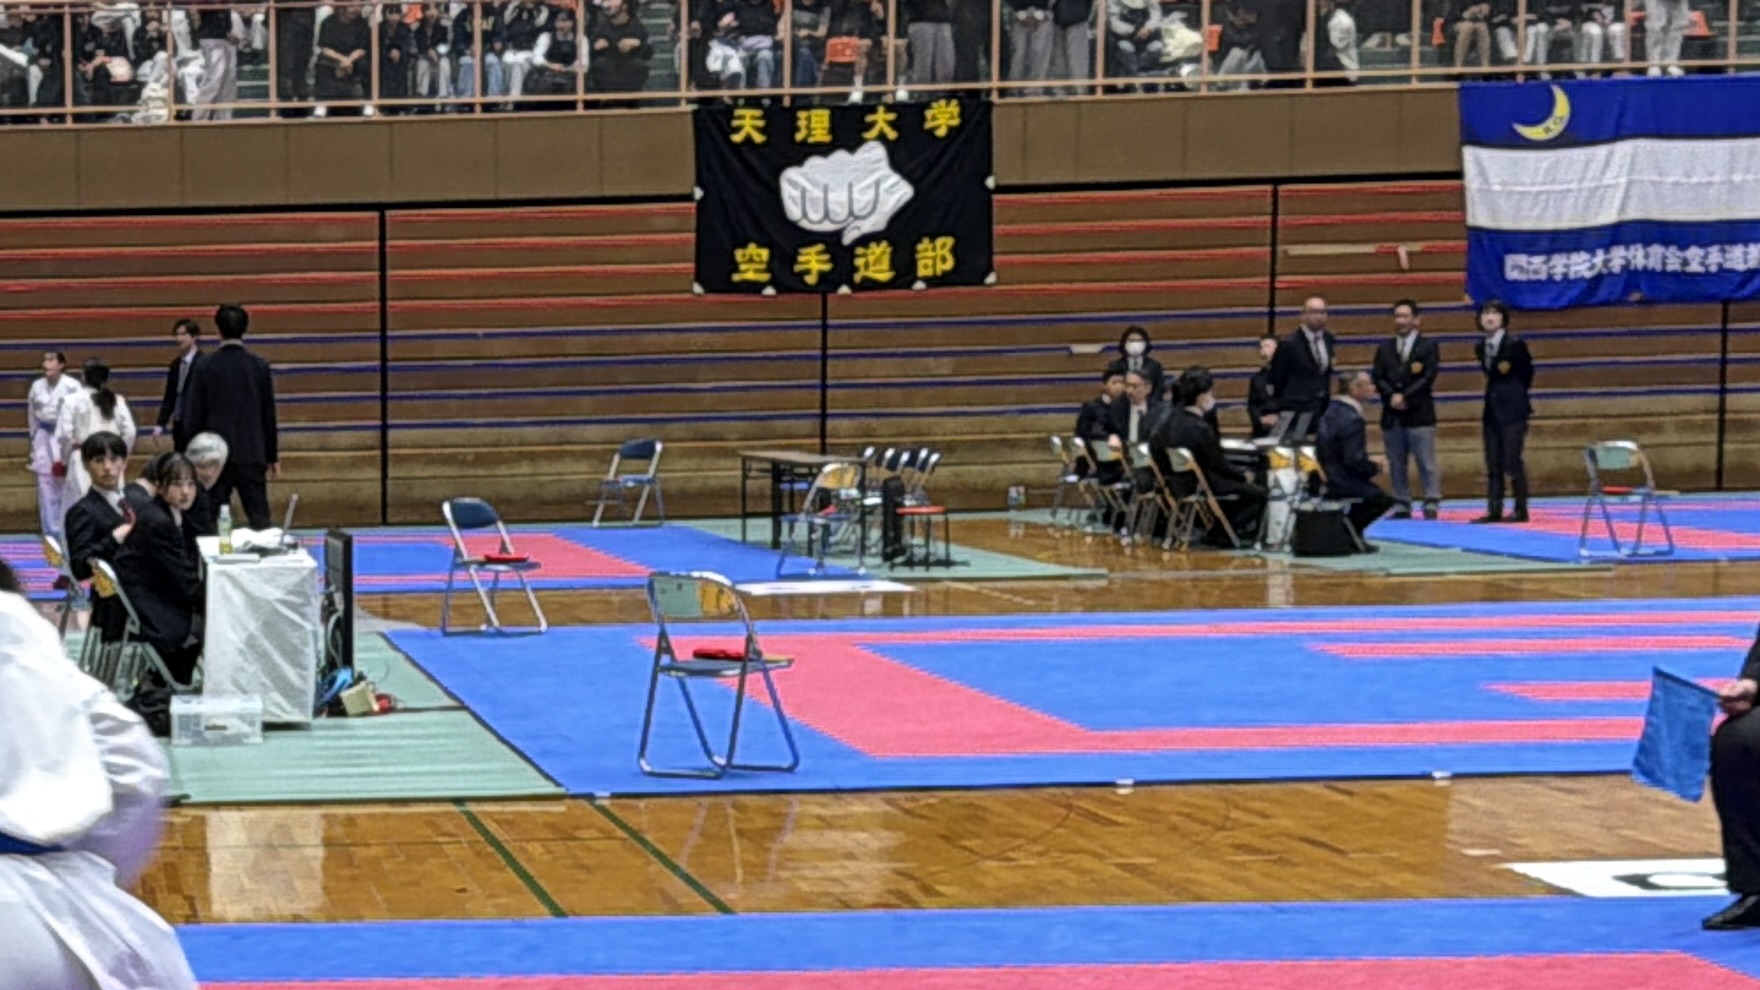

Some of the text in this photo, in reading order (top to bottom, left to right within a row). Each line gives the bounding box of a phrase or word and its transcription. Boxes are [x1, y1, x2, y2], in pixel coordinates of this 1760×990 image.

[730, 99, 961, 143] 天理大学
[731, 236, 955, 285] 空手道部
